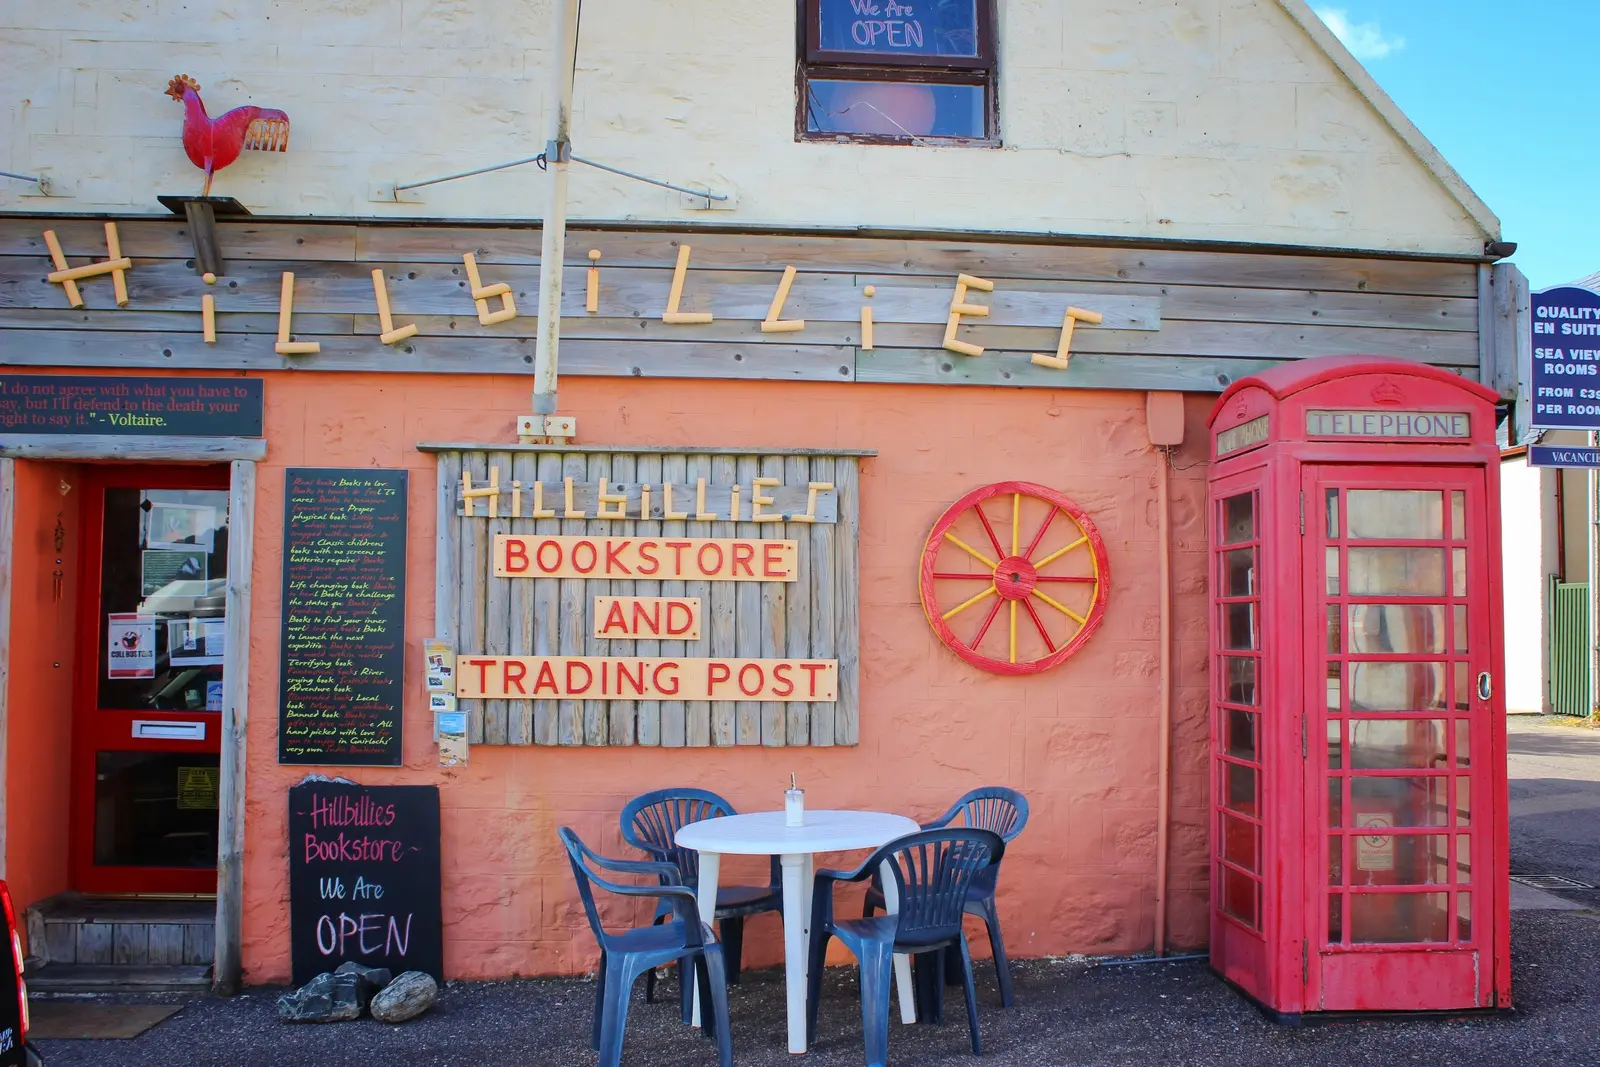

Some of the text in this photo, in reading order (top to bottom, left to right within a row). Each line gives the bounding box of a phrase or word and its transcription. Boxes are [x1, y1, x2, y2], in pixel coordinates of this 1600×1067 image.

[852, 0, 914, 17] We Are
[852, 20, 924, 47] OPEN
[1534, 322, 1554, 334] EN
[1535, 348, 1564, 360] SEA
[1544, 364, 1598, 376] ROOMS
[11, 382, 28, 394] do
[32, 384, 55, 395] not
[59, 385, 96, 398] agree
[100, 383, 129, 396] with
[133, 384, 166, 396] what
[170, 386, 194, 400] you
[198, 384, 230, 397] have
[234, 386, 248, 397] to
[1538, 388, 1574, 398] FROM
[26, 396, 48, 410] but
[74, 398, 120, 410] defend
[124, 400, 138, 411] to
[142, 398, 163, 411] the
[167, 398, 204, 411] death
[209, 402, 240, 414] your
[1537, 404, 1562, 414] PER
[32, 413, 46, 424] to
[49, 416, 71, 428] say
[108, 412, 166, 426] Voltaire.
[1314, 413, 1464, 436] TELEPHONE
[348, 504, 375, 514] Proper
[292, 512, 326, 522] physical
[505, 539, 788, 577] BOOKSTORE
[290, 581, 306, 589] Life
[310, 581, 348, 591] changing
[356, 591, 395, 600] challenge
[323, 616, 341, 625] find
[602, 600, 694, 635] AND
[288, 659, 332, 669] Terrifying
[361, 668, 384, 676] River
[469, 660, 827, 697] TRADING POST
[309, 727, 336, 736] picked
[340, 727, 357, 735] with
[310, 793, 396, 829] Hillbillies
[305, 832, 404, 864] Bookstore
[320, 876, 384, 900] We Are
[317, 912, 413, 956] OPEN
